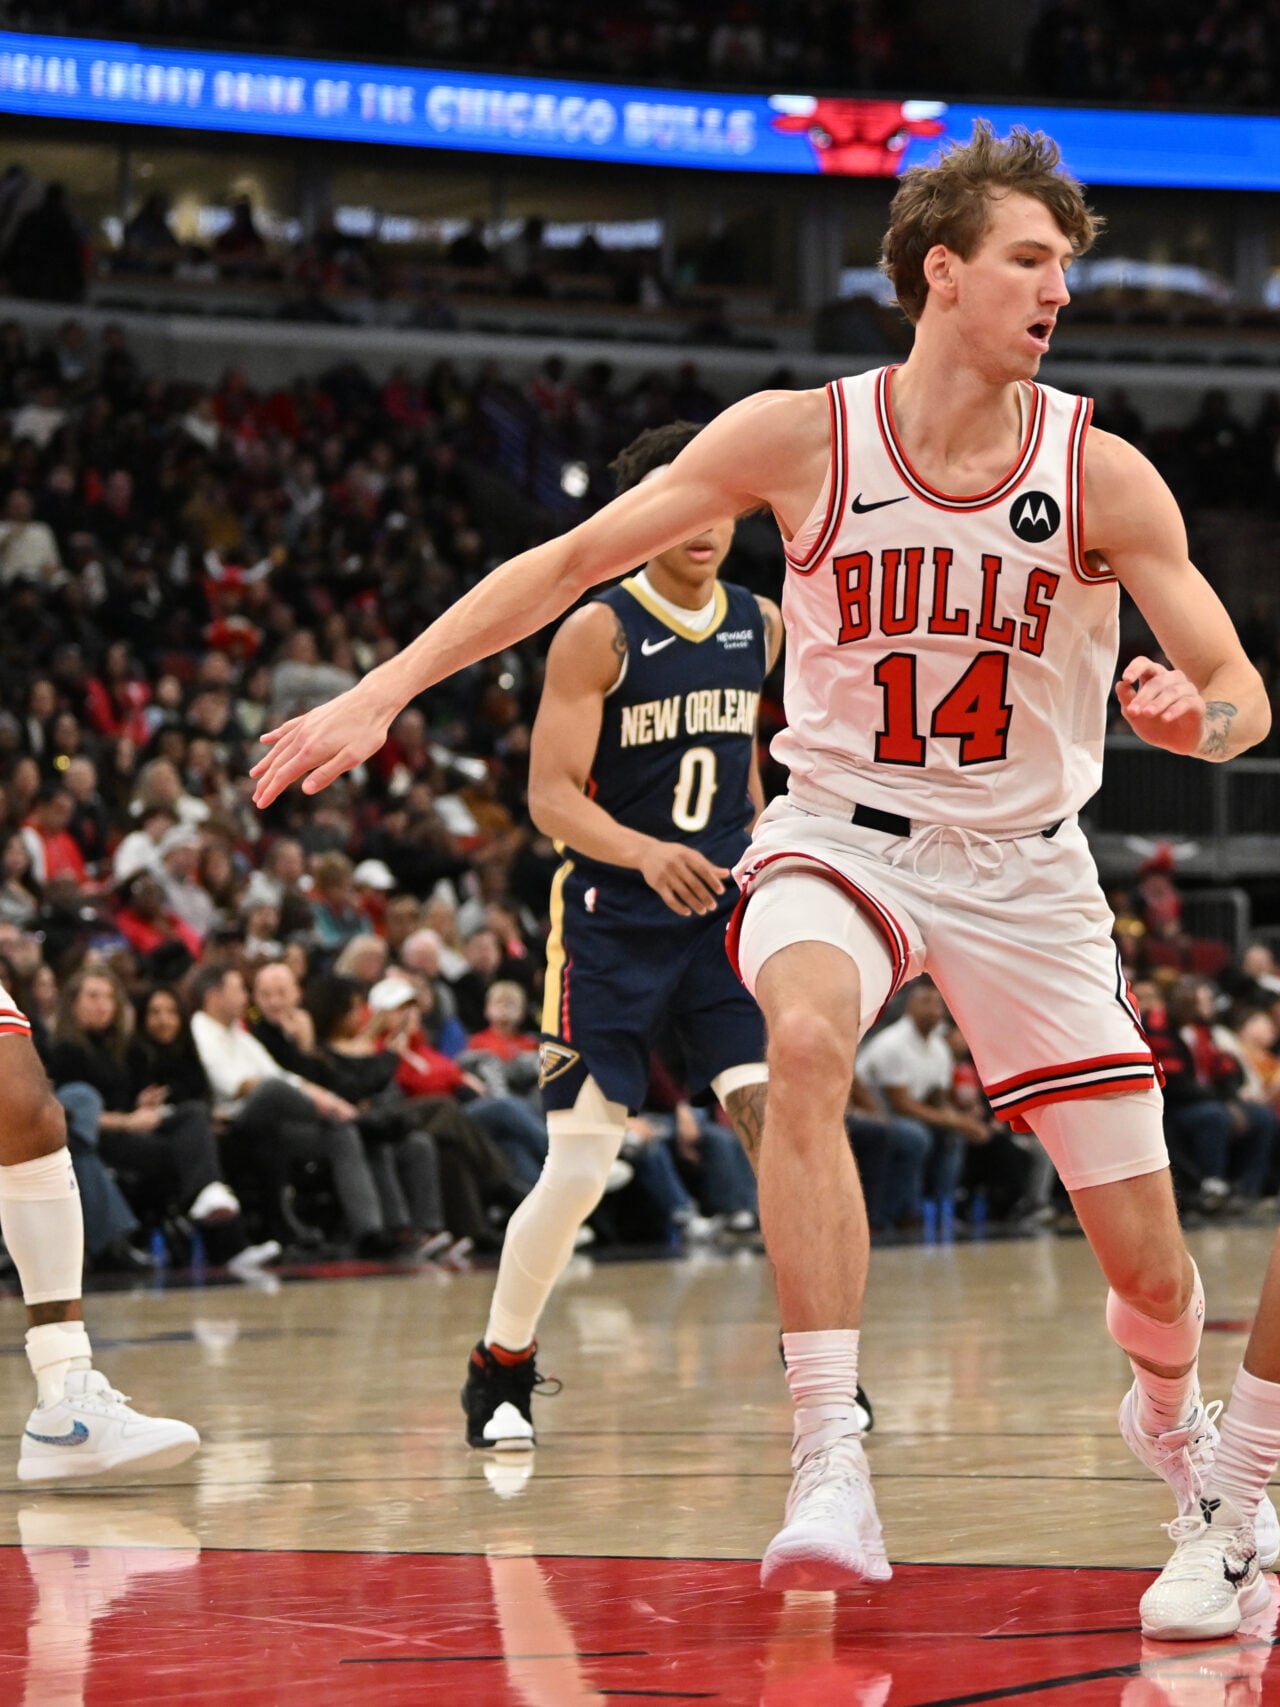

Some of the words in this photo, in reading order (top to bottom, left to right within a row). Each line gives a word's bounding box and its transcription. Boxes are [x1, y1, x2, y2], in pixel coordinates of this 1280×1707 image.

[0, 53, 79, 95] ICIAL
[426, 85, 617, 145] CHICAGO
[624, 101, 755, 155] BULLS
[833, 547, 1060, 657] BULLS
[620, 695, 681, 748] NEW
[685, 688, 760, 735] ORLEAN
[874, 650, 1013, 768] 14
[672, 745, 718, 832] 0
